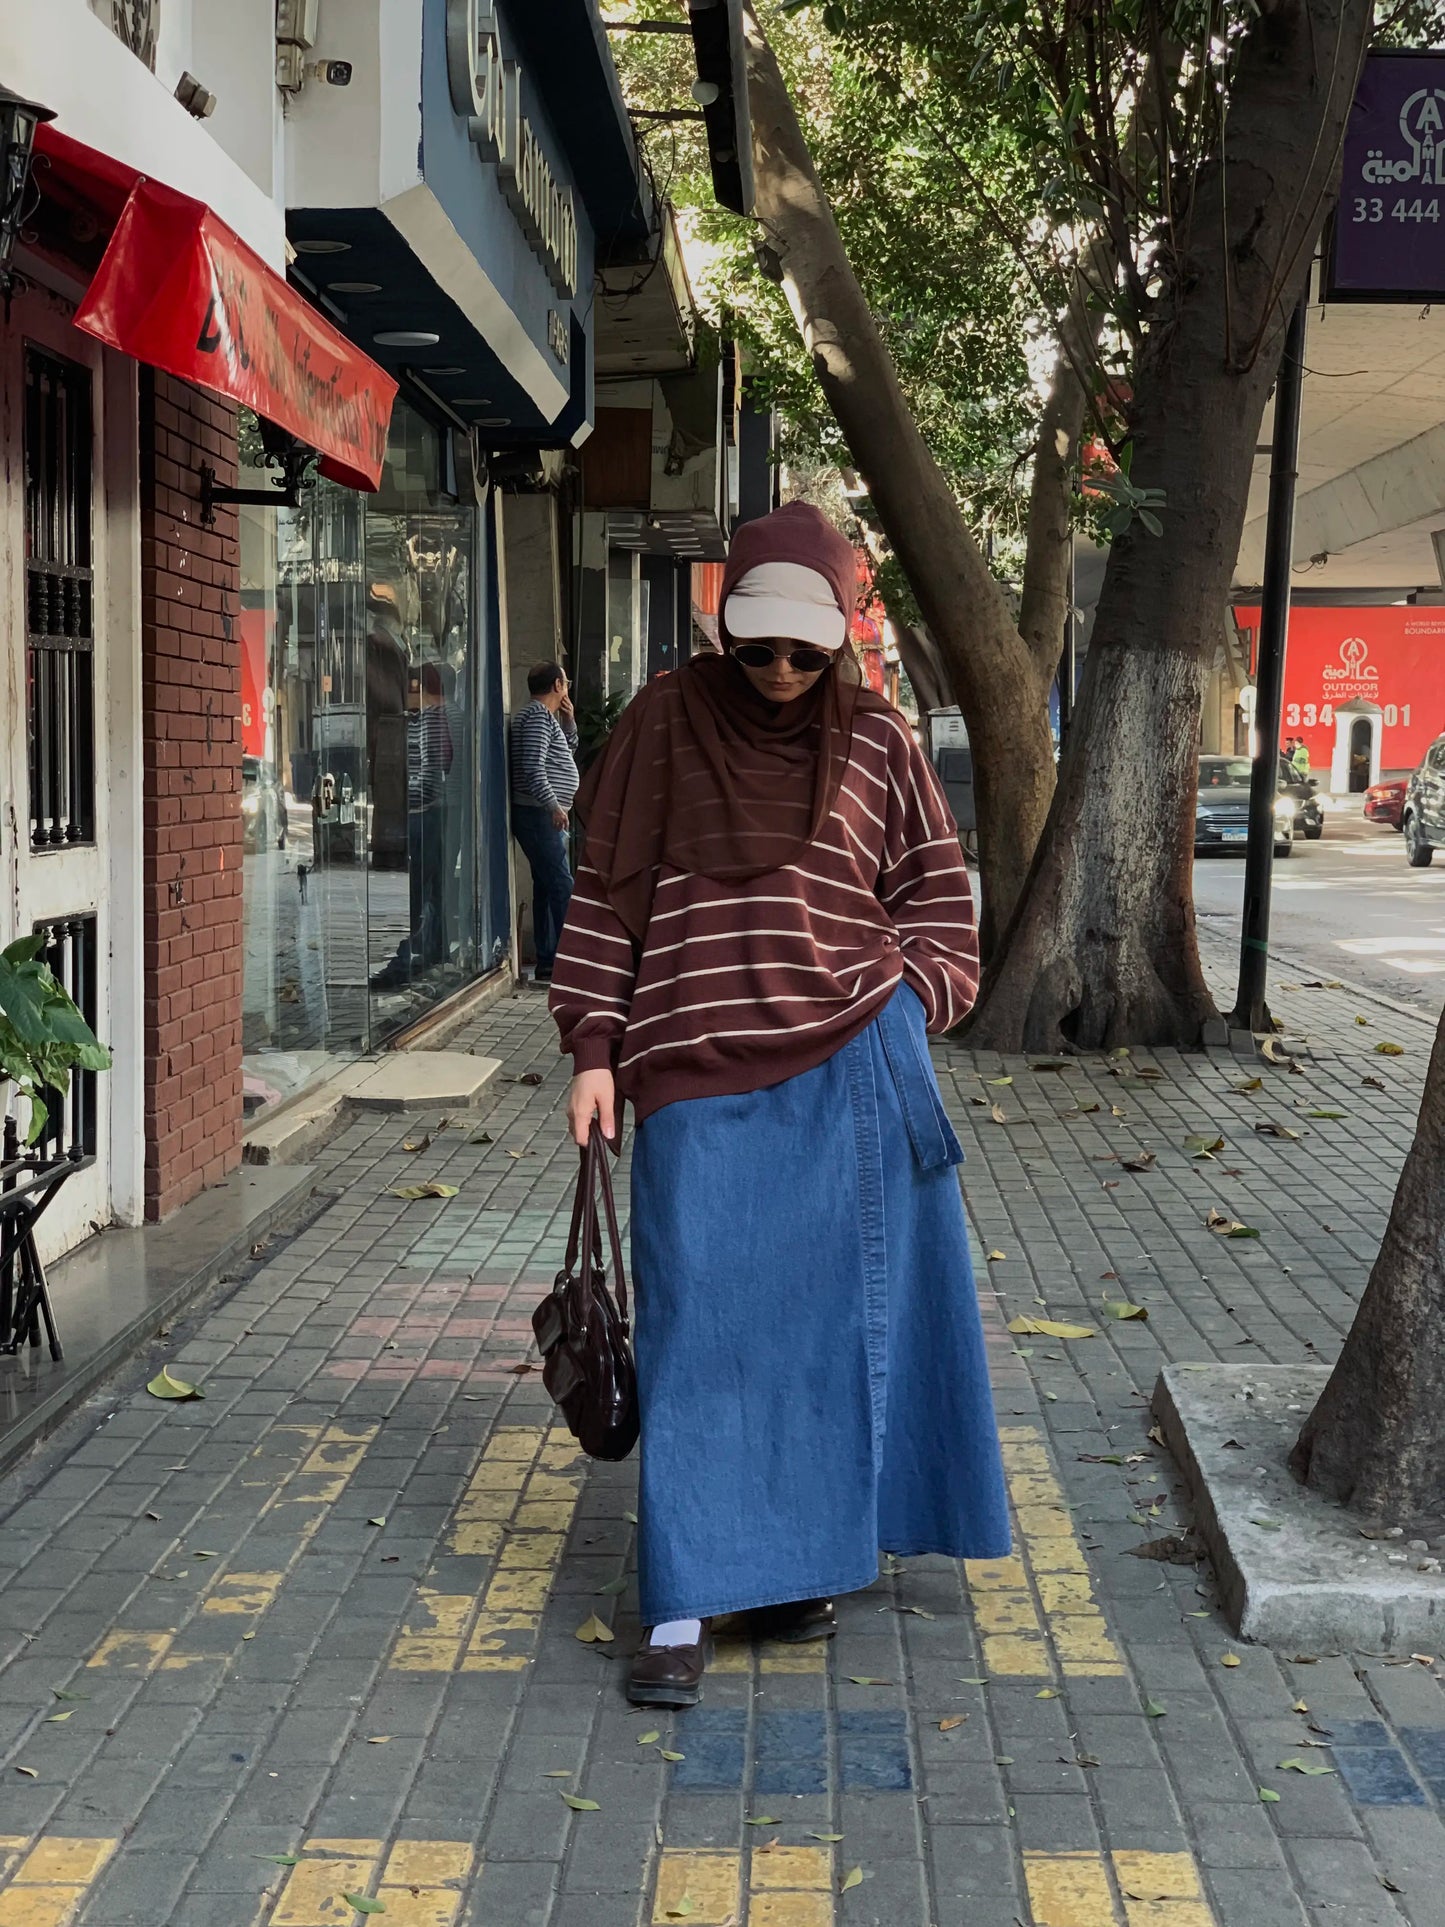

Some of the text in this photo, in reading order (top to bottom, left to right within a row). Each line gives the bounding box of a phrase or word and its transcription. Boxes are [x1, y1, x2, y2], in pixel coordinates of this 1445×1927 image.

[1352, 197, 1440, 223] 33 444
[1322, 683, 1378, 691] OUTDOOR
